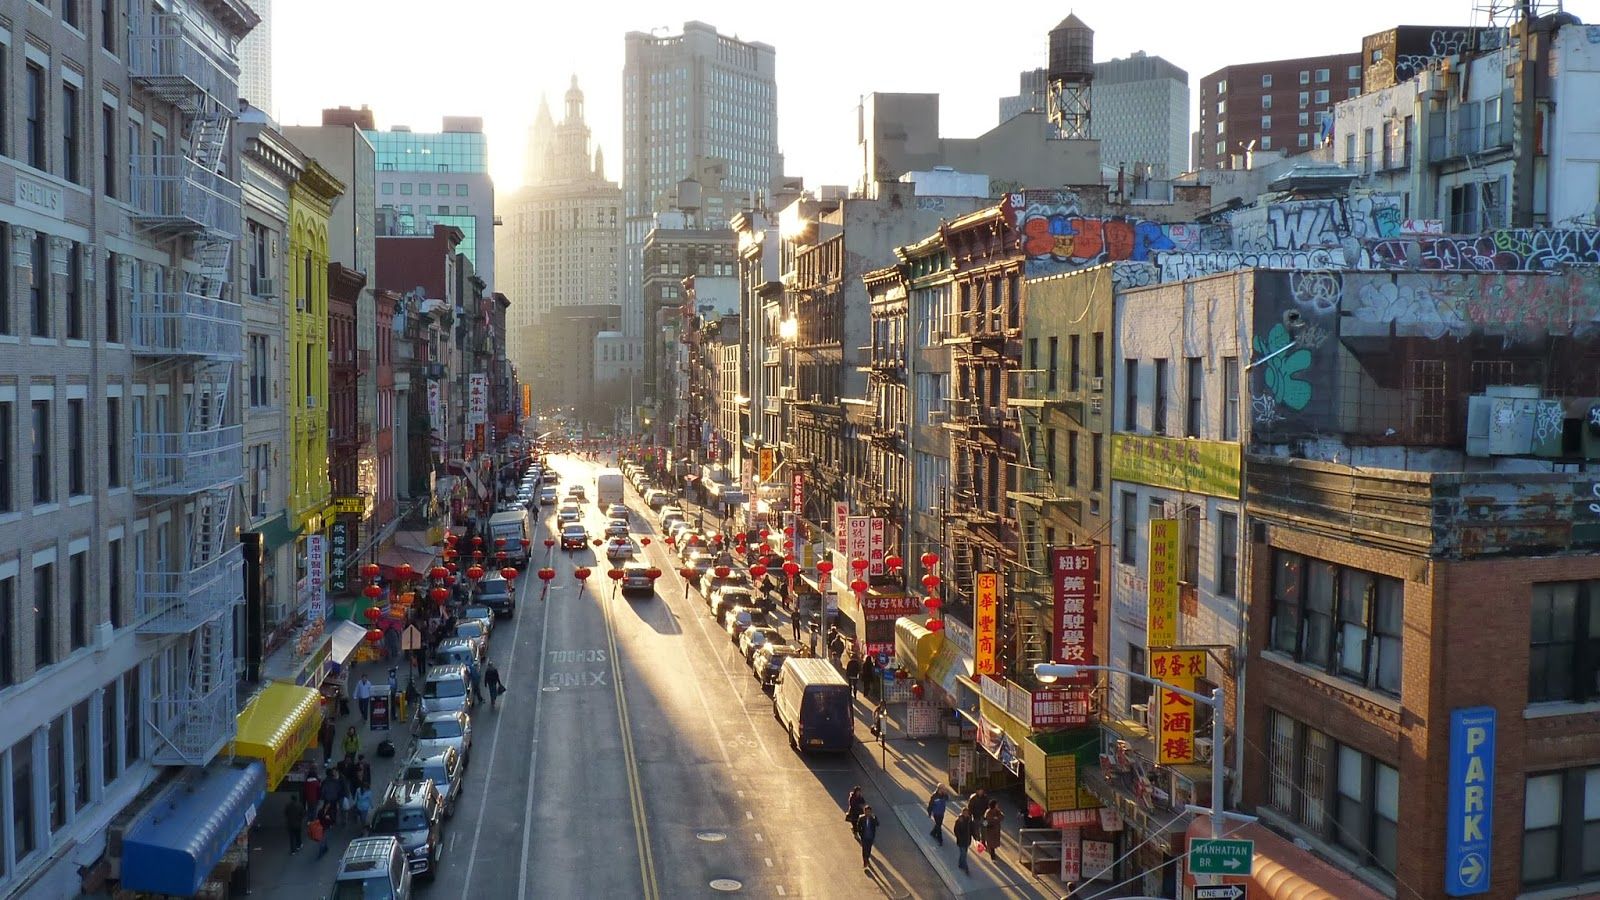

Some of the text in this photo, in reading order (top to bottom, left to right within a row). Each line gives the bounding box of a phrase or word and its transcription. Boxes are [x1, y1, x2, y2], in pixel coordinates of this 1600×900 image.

[1059, 555, 1089, 570] 紐約
[979, 576, 994, 589] 66
[548, 649, 606, 663] SCHOOL
[549, 671, 607, 687] XING
[1463, 726, 1486, 842] PARK
[1196, 845, 1248, 855] MANHATTAN
[1201, 888, 1239, 898] ONE WAY
